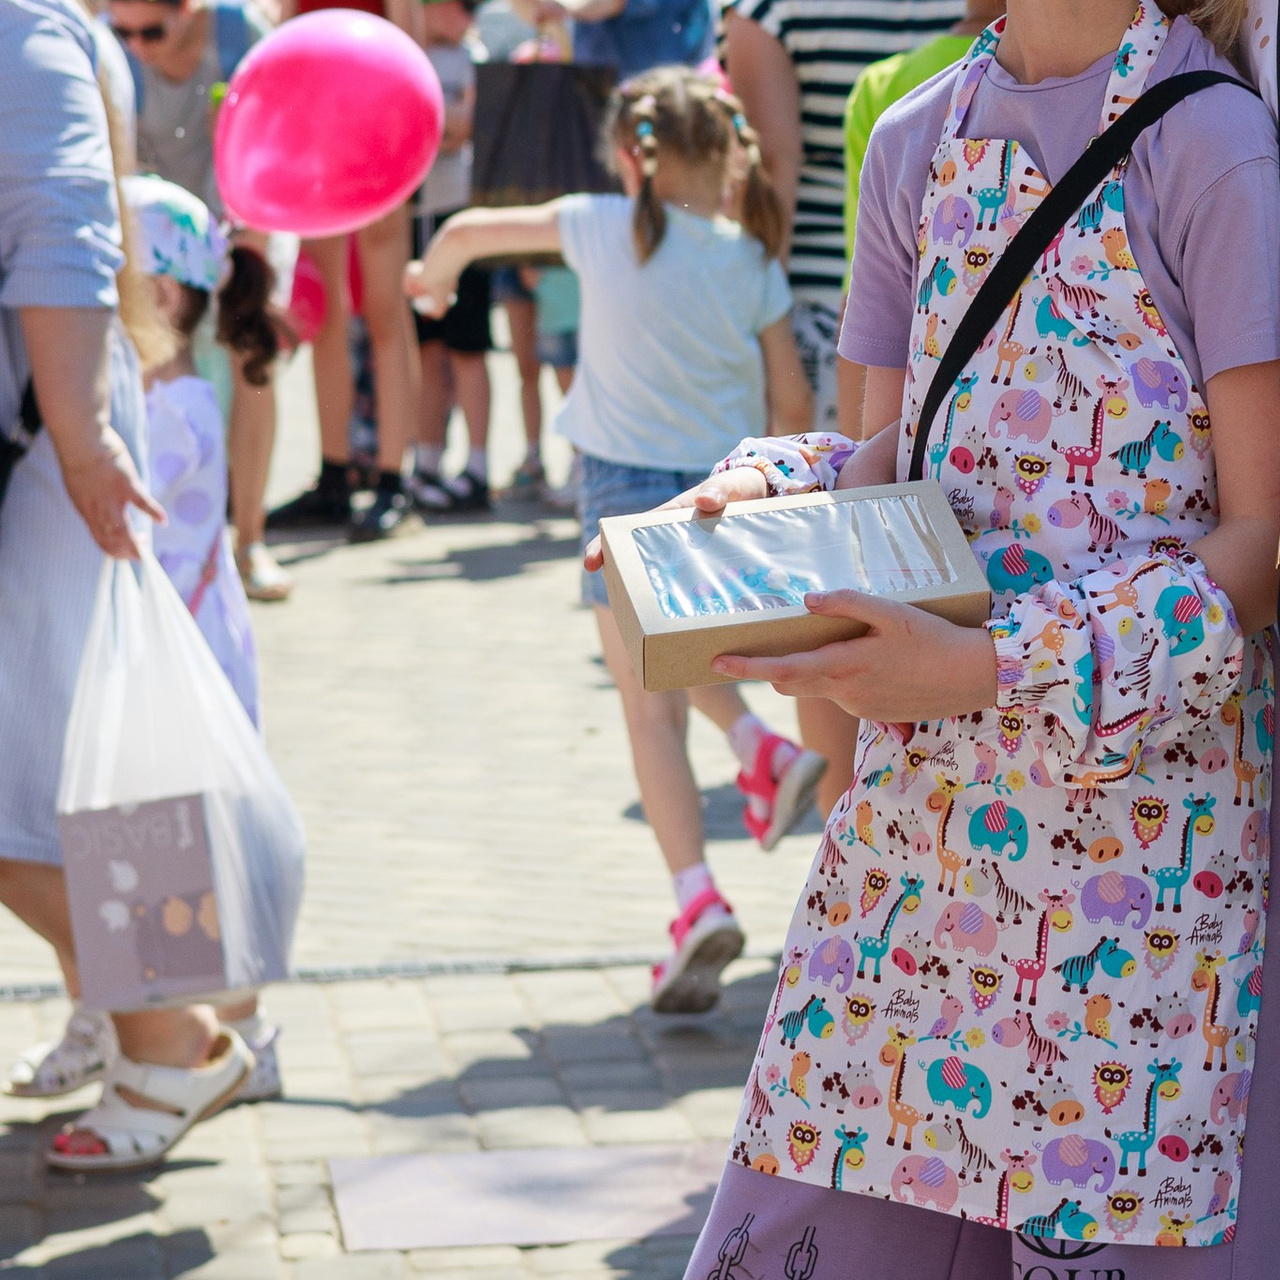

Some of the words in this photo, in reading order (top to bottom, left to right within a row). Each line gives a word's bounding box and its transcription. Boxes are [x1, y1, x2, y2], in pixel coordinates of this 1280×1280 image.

[1195, 912, 1223, 933] Baby
[1185, 925, 1223, 946] Animals
[892, 987, 920, 1011] Baby
[880, 998, 919, 1023] Animals
[1160, 1176, 1192, 1196] Baby
[1149, 1188, 1193, 1209] Animals
